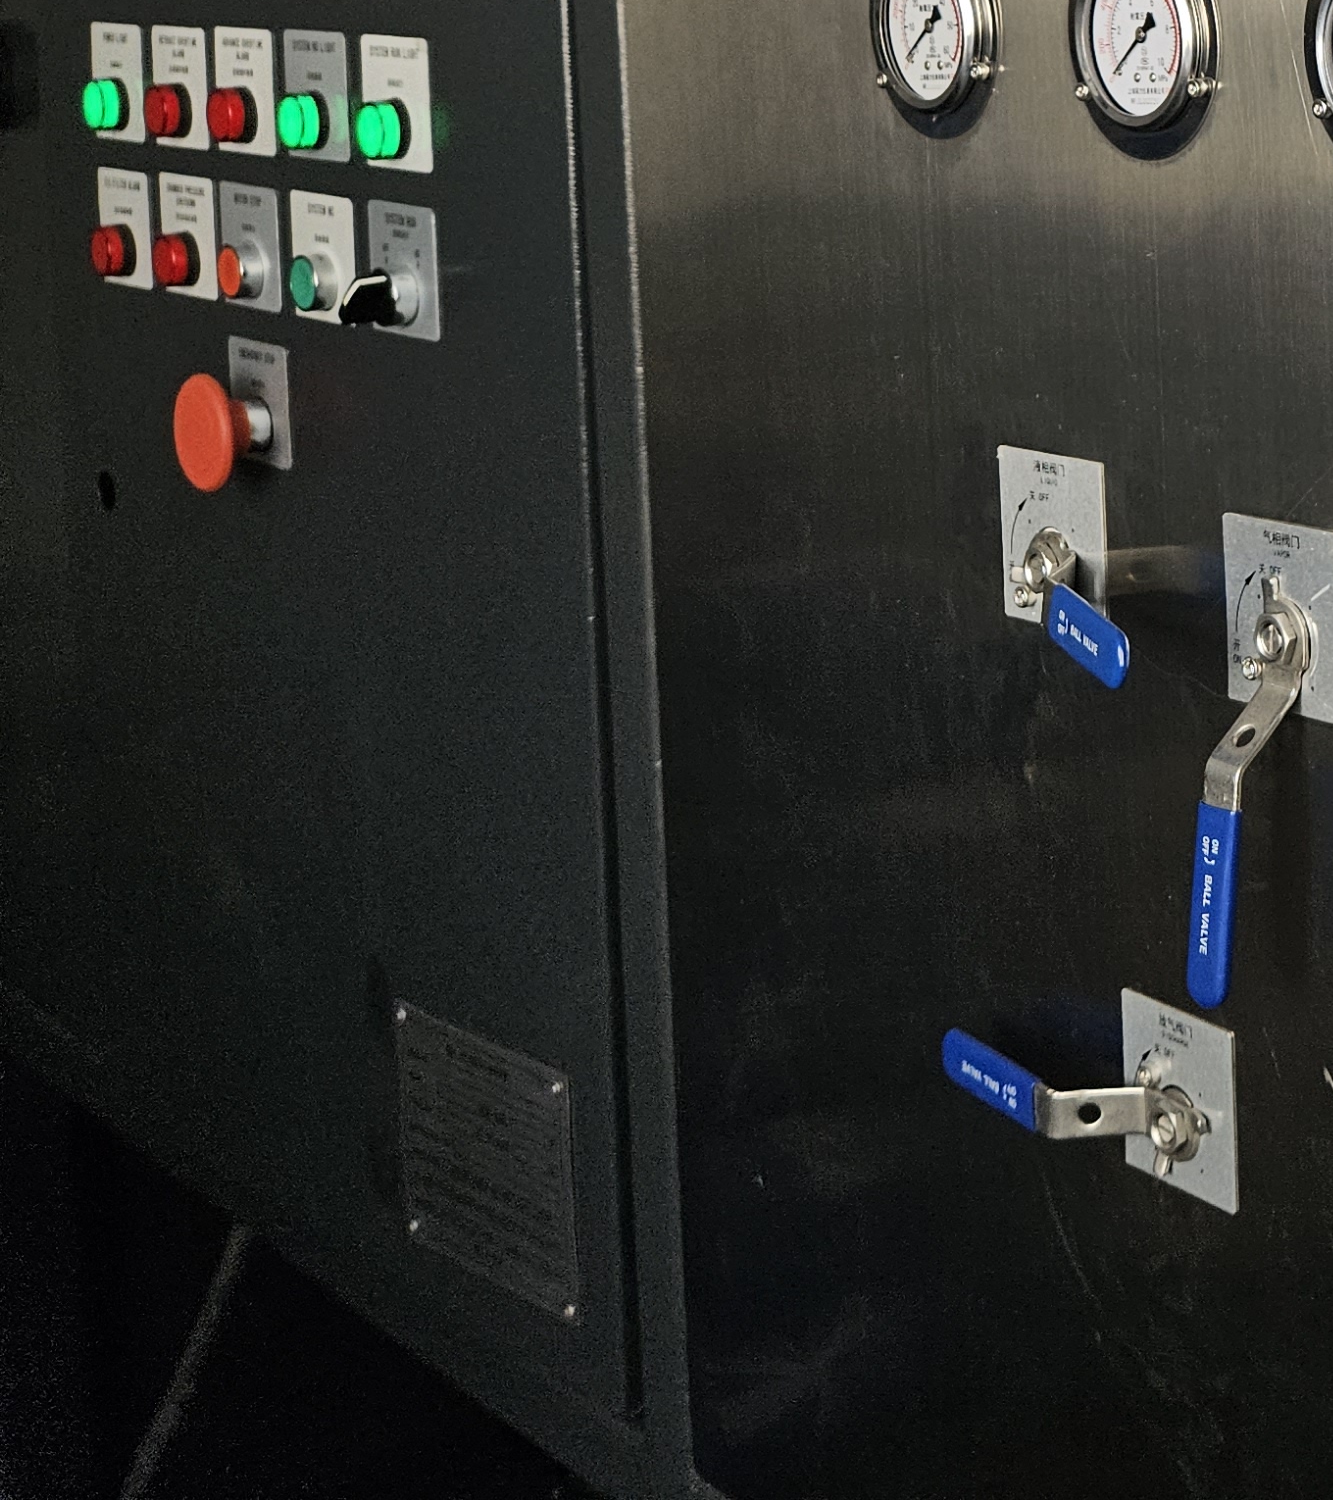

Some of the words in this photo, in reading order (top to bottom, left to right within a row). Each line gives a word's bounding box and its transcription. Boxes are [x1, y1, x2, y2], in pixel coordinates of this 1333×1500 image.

[1263, 529, 1300, 549] 气相阀门
[1070, 624, 1082, 643] BALL
[1083, 633, 1099, 656] VALVE
[1202, 835, 1210, 856] OFF
[1211, 838, 1219, 855] ON
[1203, 874, 1213, 907] BALL
[1199, 913, 1210, 956] VALVE
